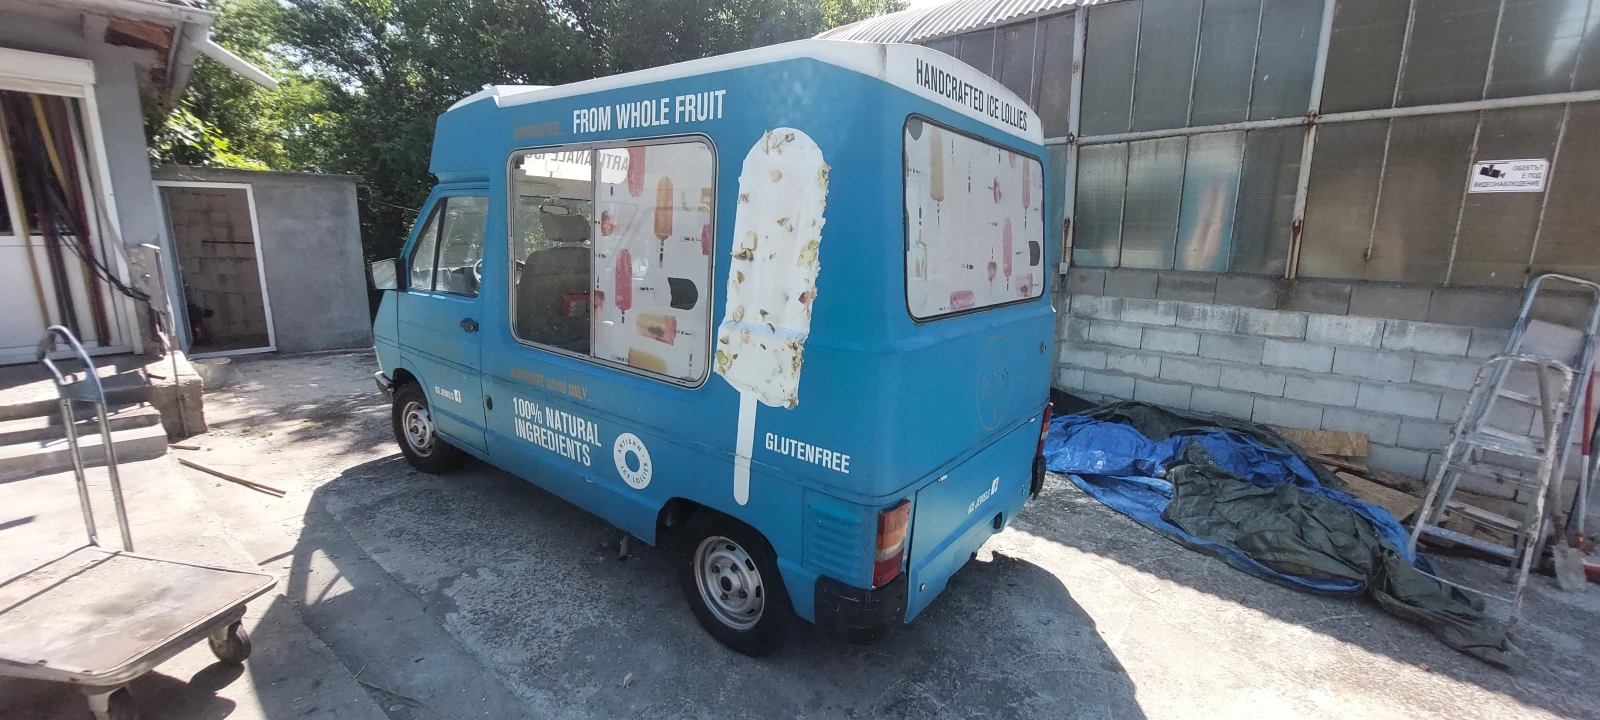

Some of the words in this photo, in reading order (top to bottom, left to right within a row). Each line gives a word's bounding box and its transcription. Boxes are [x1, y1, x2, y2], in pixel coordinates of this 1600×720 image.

[573, 106, 611, 134] FROM
[616, 97, 670, 130] WHOLE
[675, 89, 727, 124] FRUIT
[916, 58, 984, 112] HANDCRAFTED
[986, 93, 999, 119] ICE
[1001, 100, 1028, 132] LOLLIES
[1473, 180, 1540, 188] ВИДЕОНАБЛЮДЕНИЕ
[513, 396, 543, 424] 100%
[545, 406, 602, 447] NATURAL
[514, 417, 591, 467] INGREDIENTS
[617, 438, 642, 455] ARTISAN
[765, 432, 851, 474] GLUTENFREE
[620, 465, 631, 480] ICE
[632, 462, 649, 484] LOLLIES
